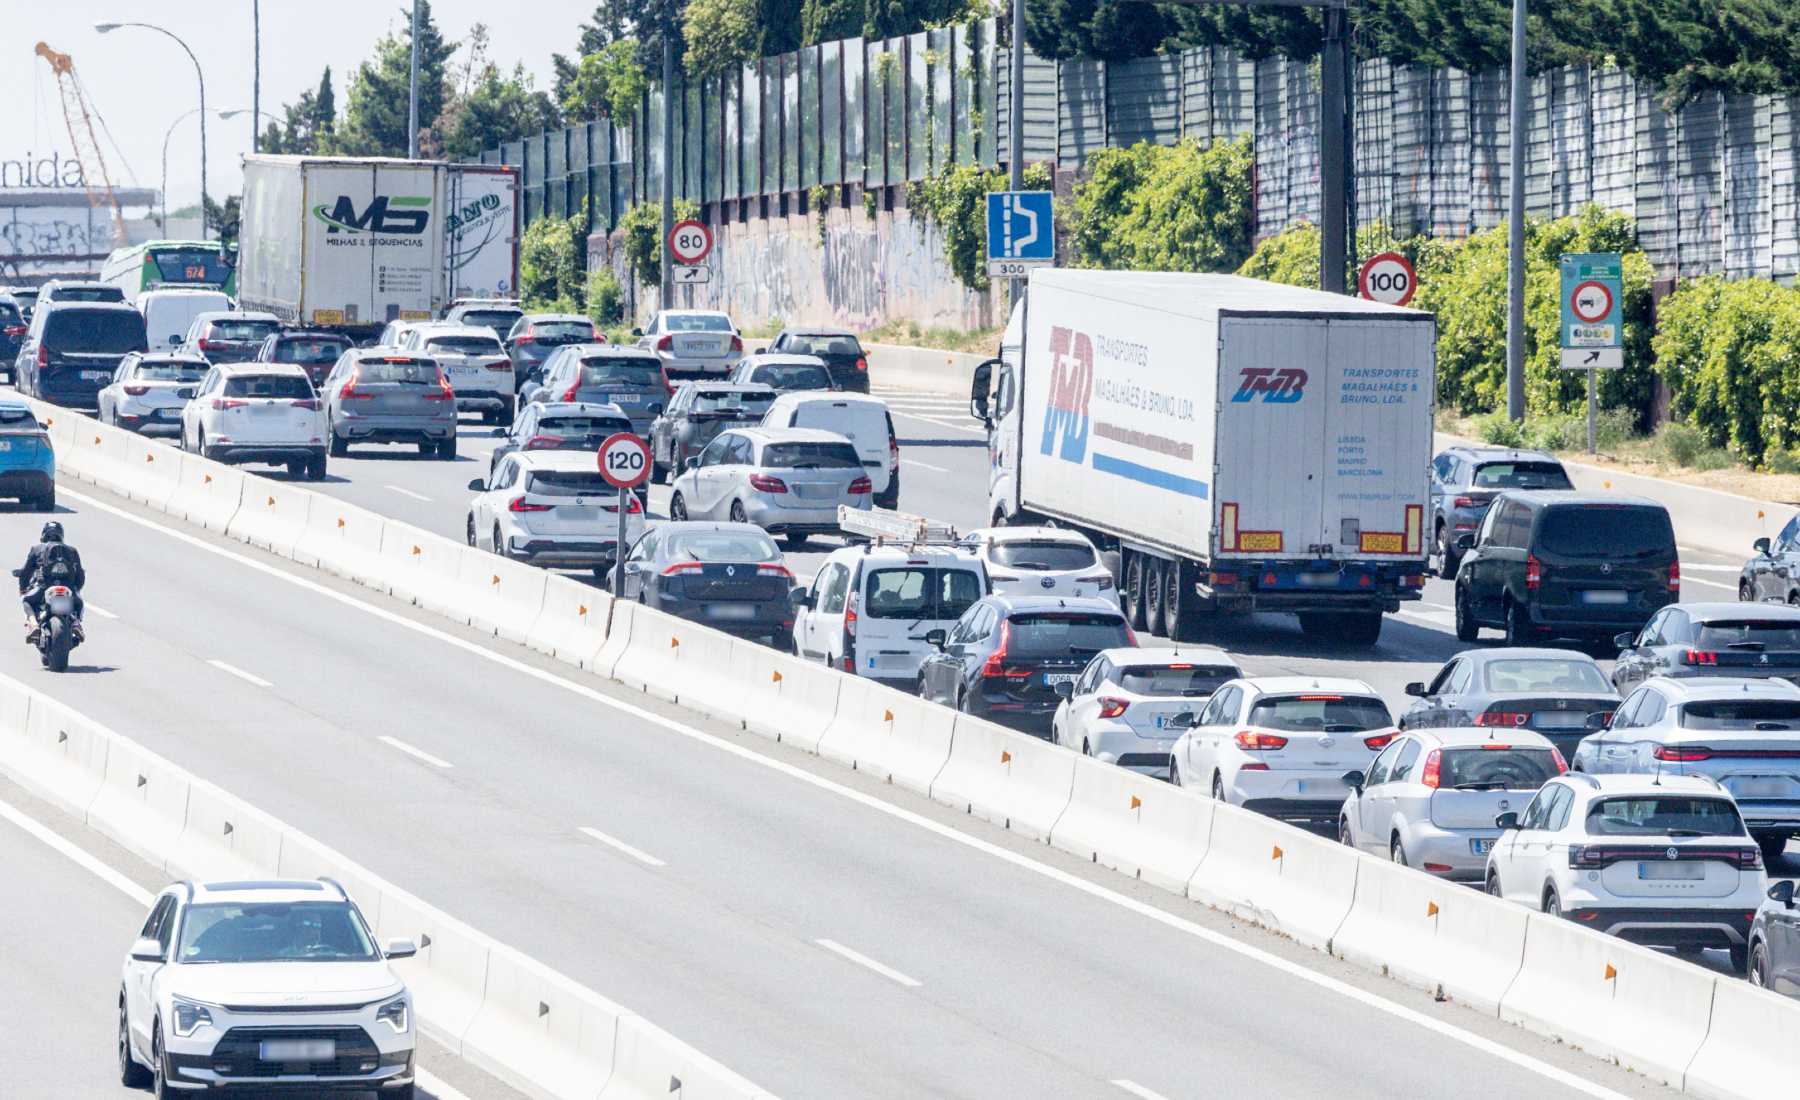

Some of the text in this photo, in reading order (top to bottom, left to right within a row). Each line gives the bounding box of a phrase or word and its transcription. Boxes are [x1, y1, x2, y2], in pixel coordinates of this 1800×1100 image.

[326, 238, 358, 247] MILHAS
[680, 234, 703, 249] 80
[1000, 264, 1025, 274] 300
[1369, 272, 1408, 292] 100
[1096, 334, 1149, 367] TRANSPORTES
[1343, 368, 1419, 378] TRANSPORTES
[1230, 367, 1309, 404] TMB
[1411, 383, 1418, 392] &
[607, 451, 644, 470] 120
